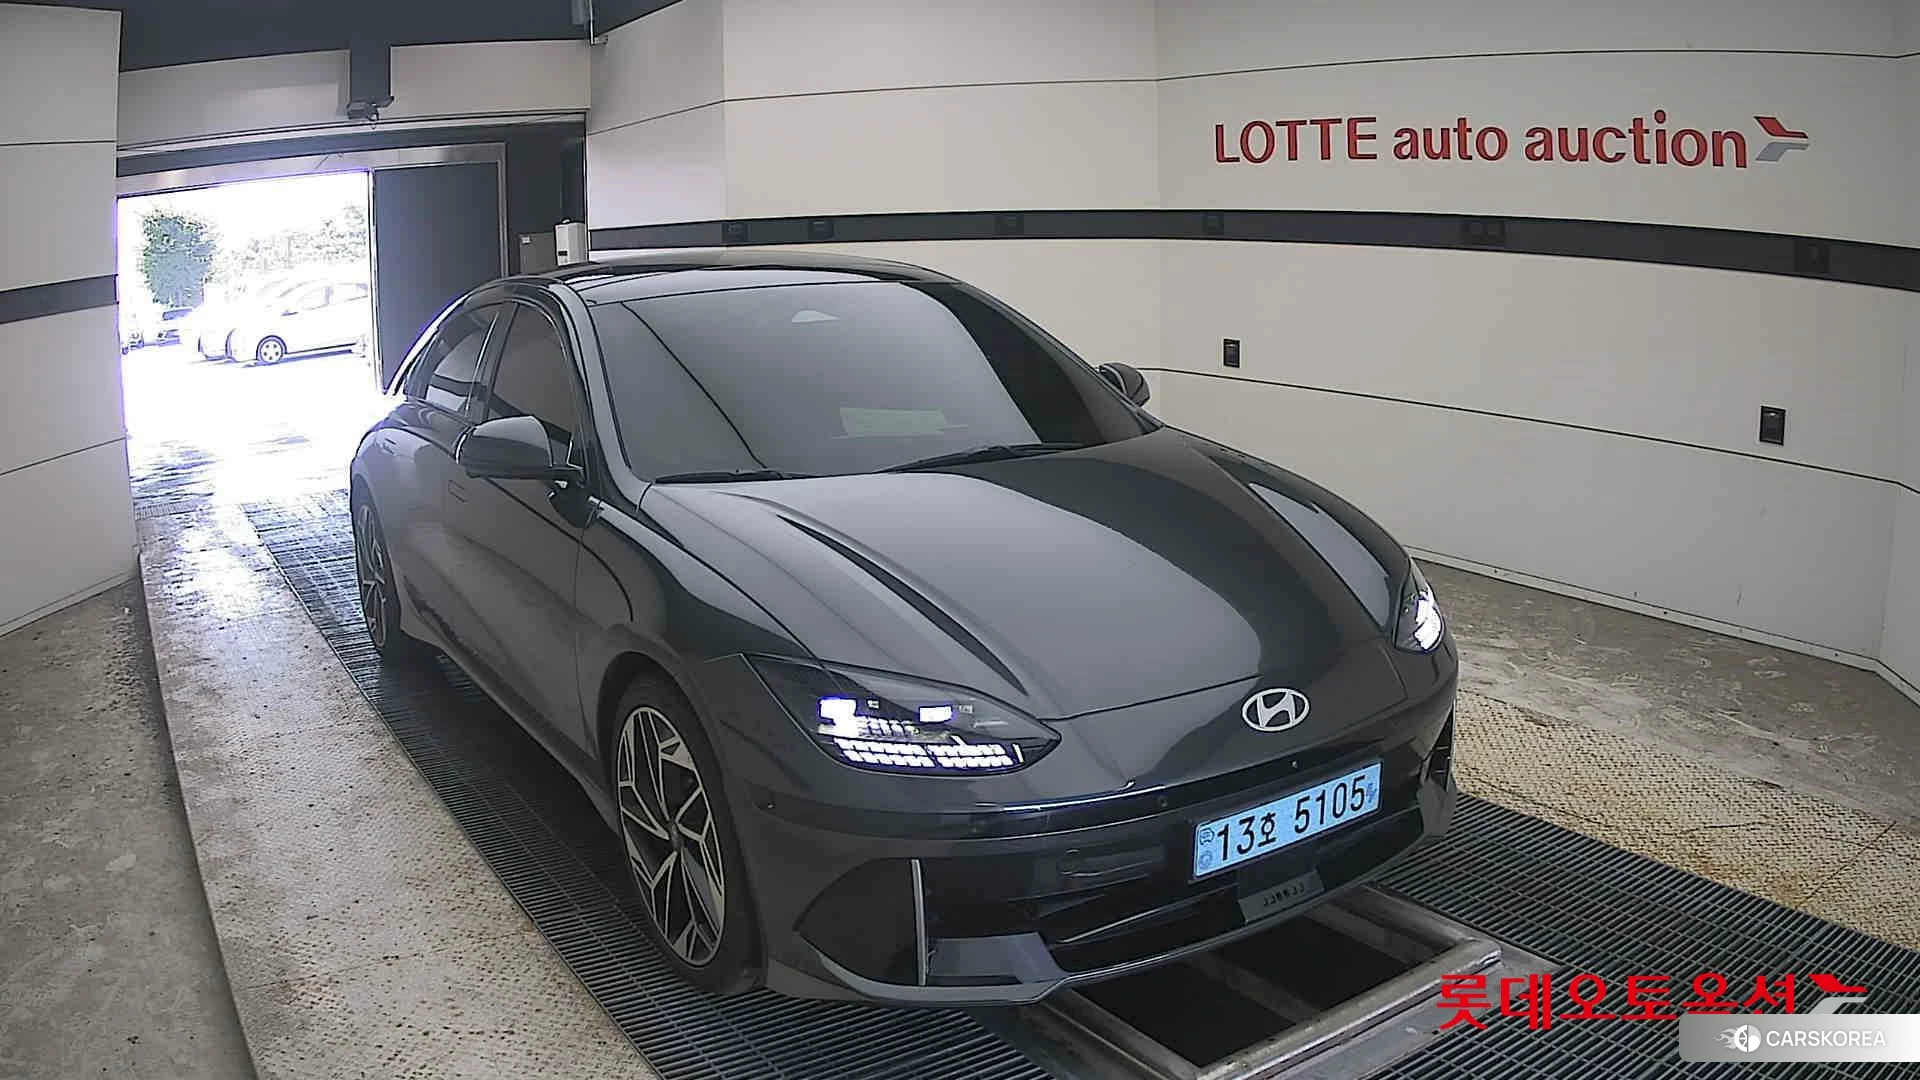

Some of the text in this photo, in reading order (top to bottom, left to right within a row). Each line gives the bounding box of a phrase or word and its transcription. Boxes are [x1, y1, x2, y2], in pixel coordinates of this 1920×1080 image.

[1215, 109, 1747, 168] LOTTE auto auction
[1217, 775, 1366, 861] 13호 5105
